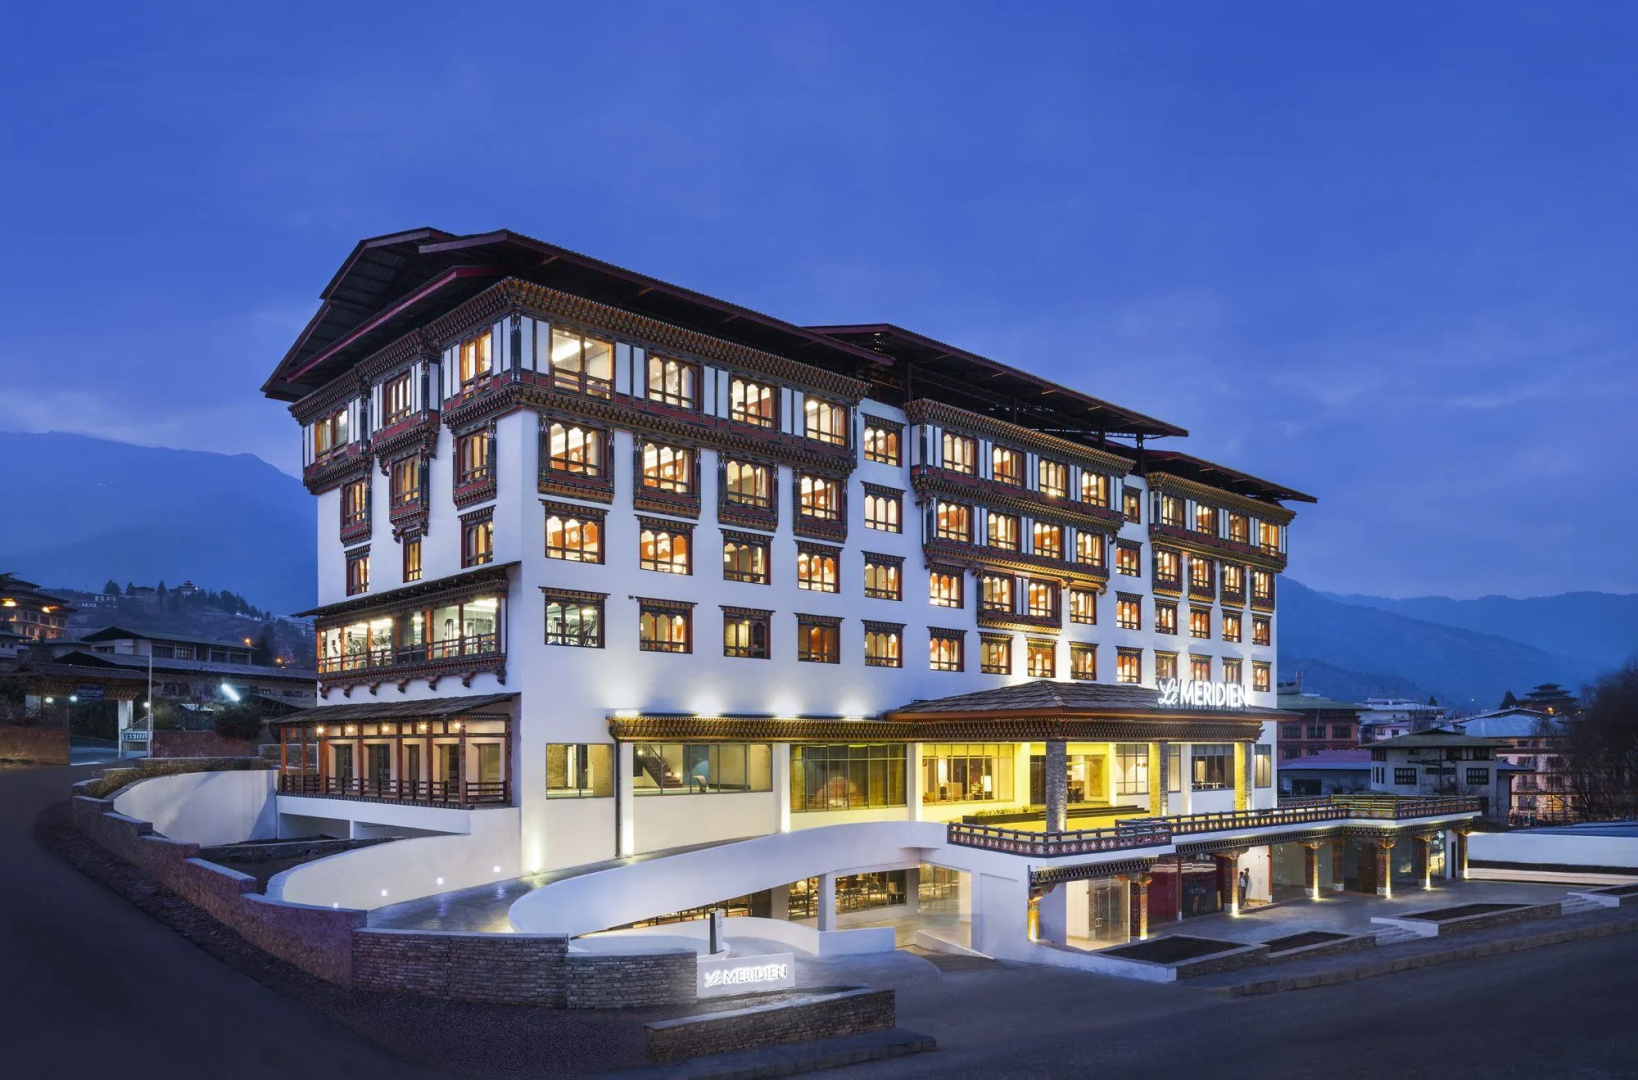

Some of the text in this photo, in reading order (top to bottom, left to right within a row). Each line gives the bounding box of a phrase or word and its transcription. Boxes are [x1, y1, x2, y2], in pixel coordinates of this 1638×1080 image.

[1158, 678, 1248, 707] Le MERIDIEN
[723, 963, 787, 985] MERIDIEN
